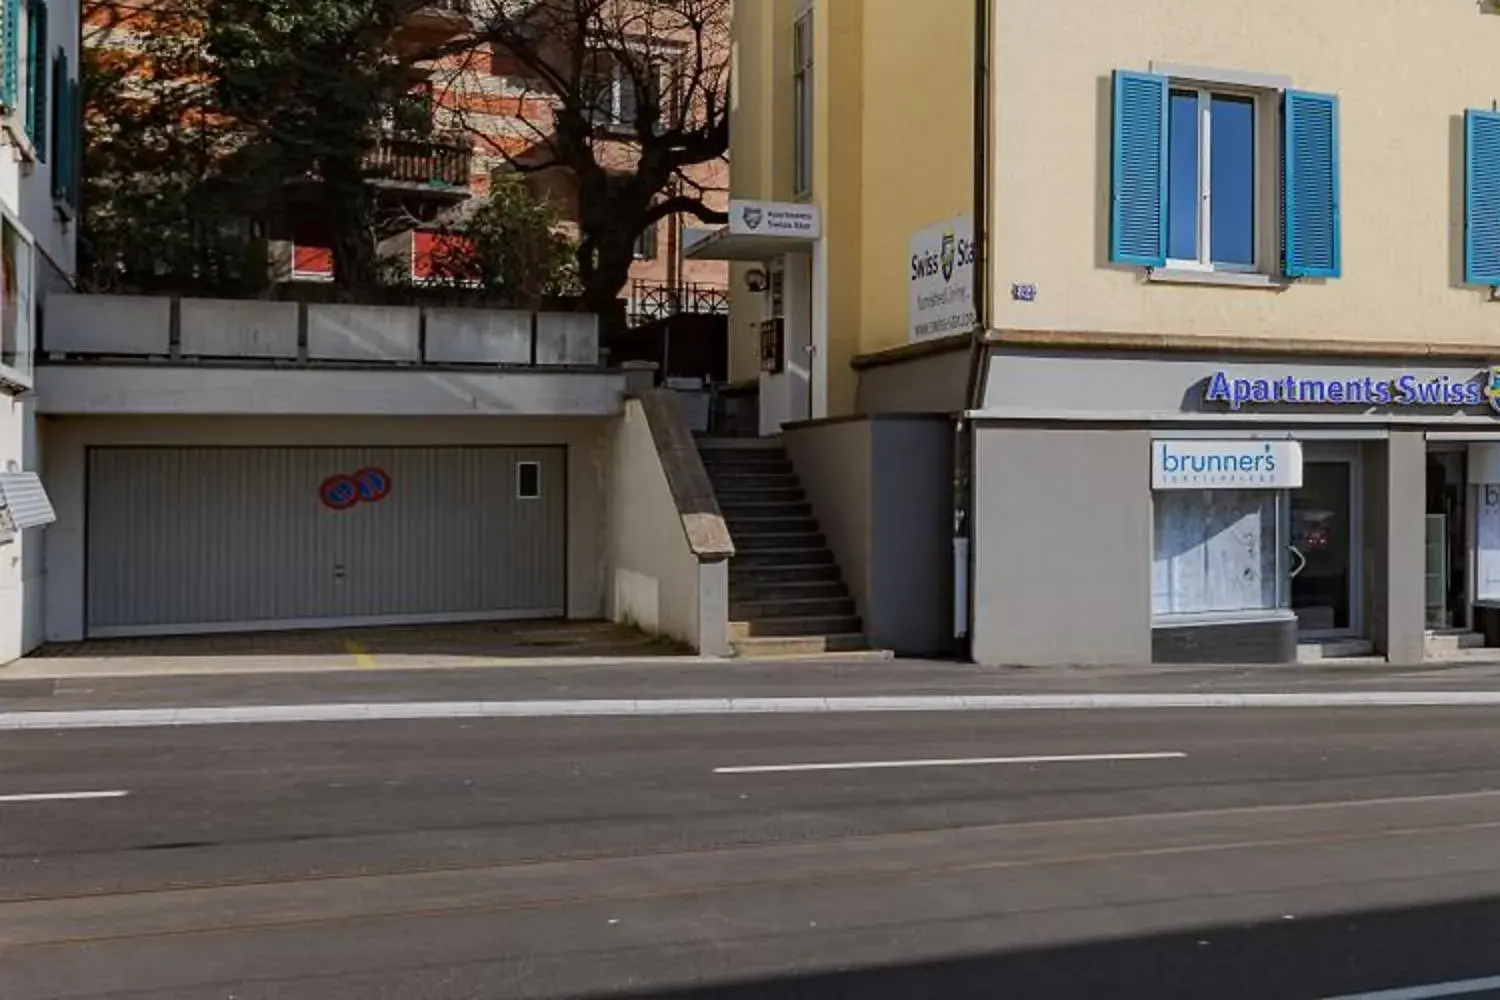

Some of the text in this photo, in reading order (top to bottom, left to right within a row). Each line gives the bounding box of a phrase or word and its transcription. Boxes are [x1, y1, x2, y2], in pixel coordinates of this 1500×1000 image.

[911, 238, 976, 281] Swiss Sta
[1209, 371, 1390, 410] Apartments
[1397, 374, 1481, 405] Swiss
[1162, 443, 1275, 472] brunner's
